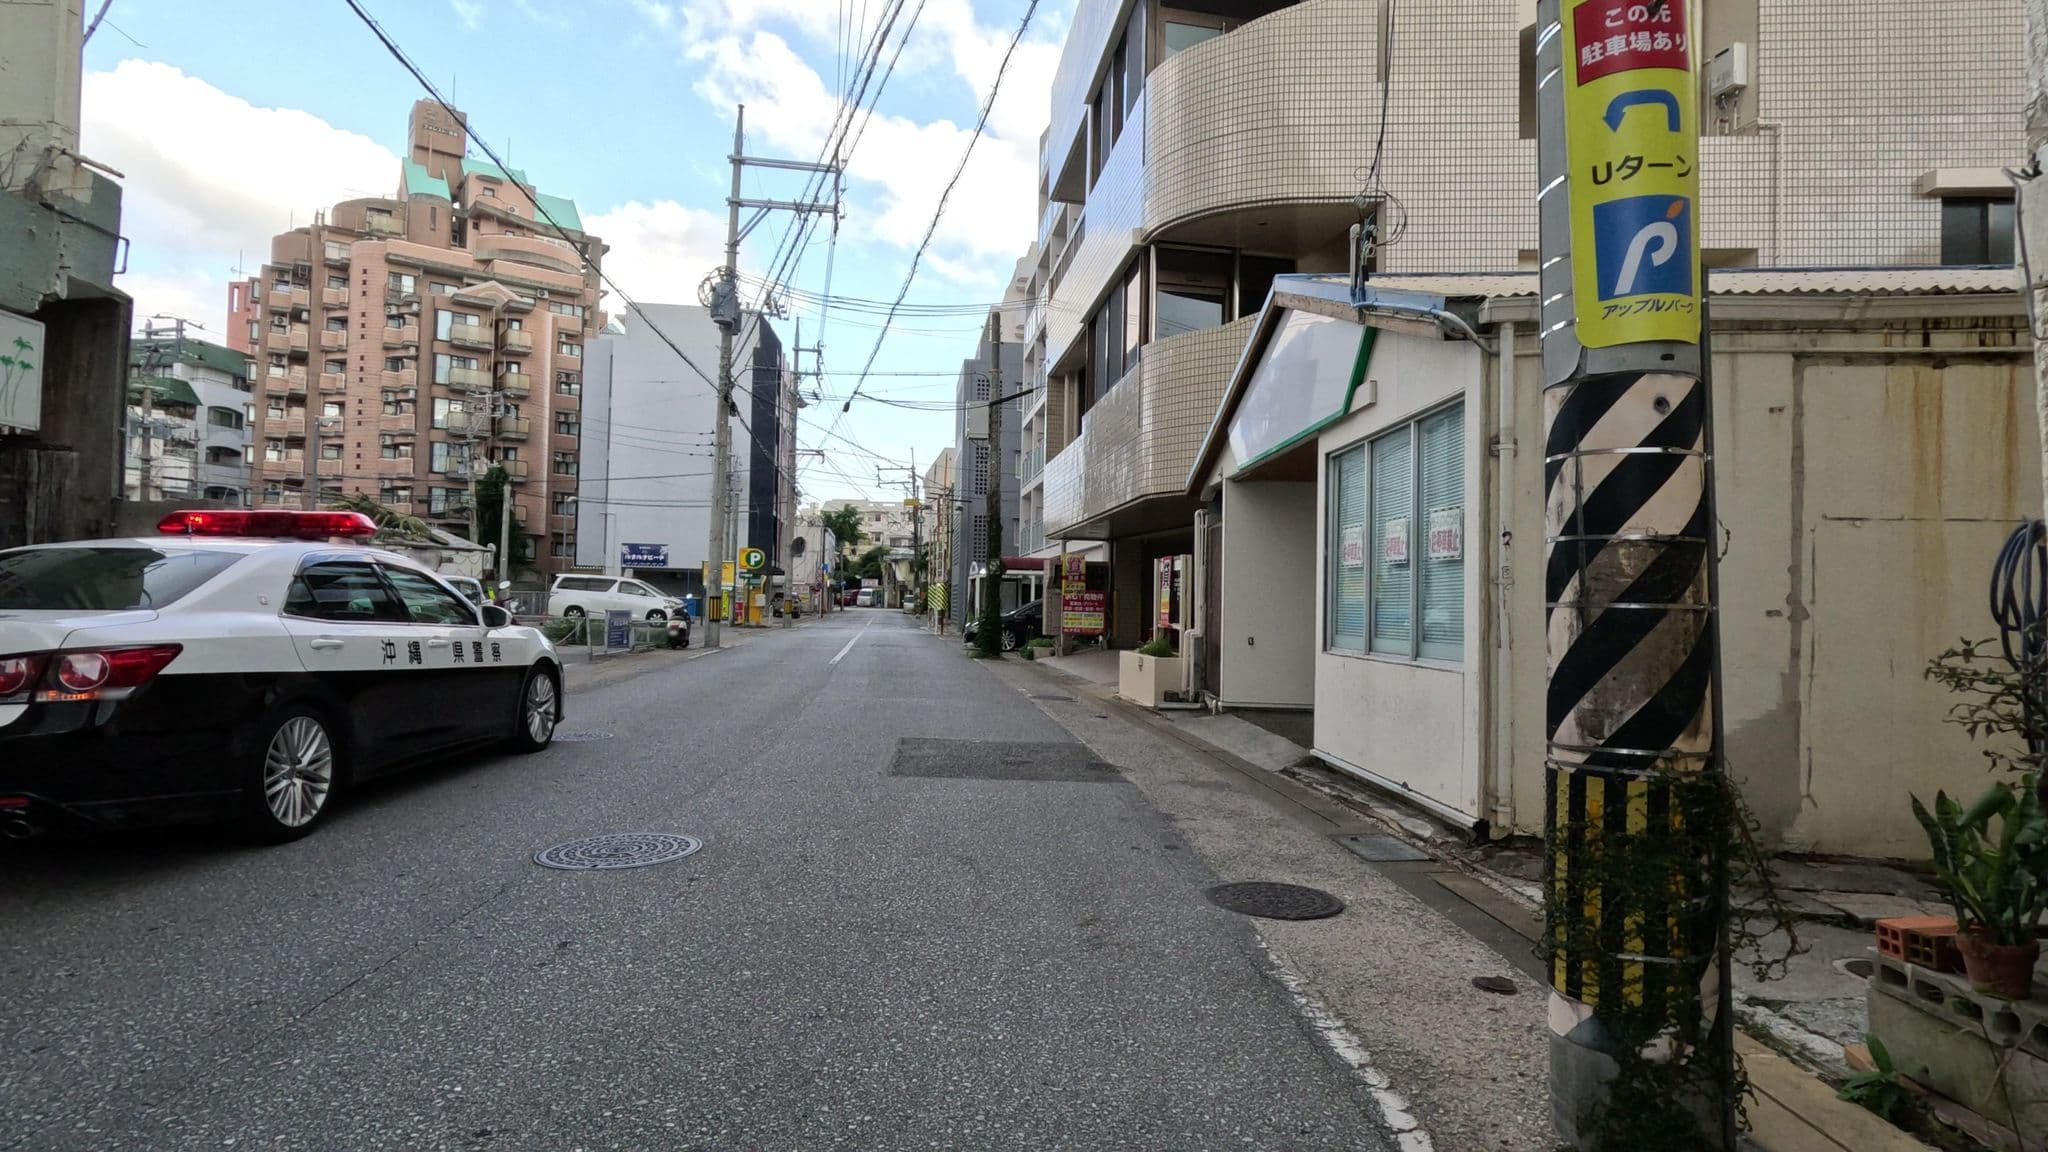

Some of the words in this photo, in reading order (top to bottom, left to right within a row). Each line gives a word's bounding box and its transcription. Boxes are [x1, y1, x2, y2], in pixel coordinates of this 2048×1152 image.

[1581, 30, 1688, 67] 駐車場あり
[1591, 155, 1692, 186] Uターン
[750, 552, 761, 566] P
[381, 639, 502, 665] 沖縄県警察
